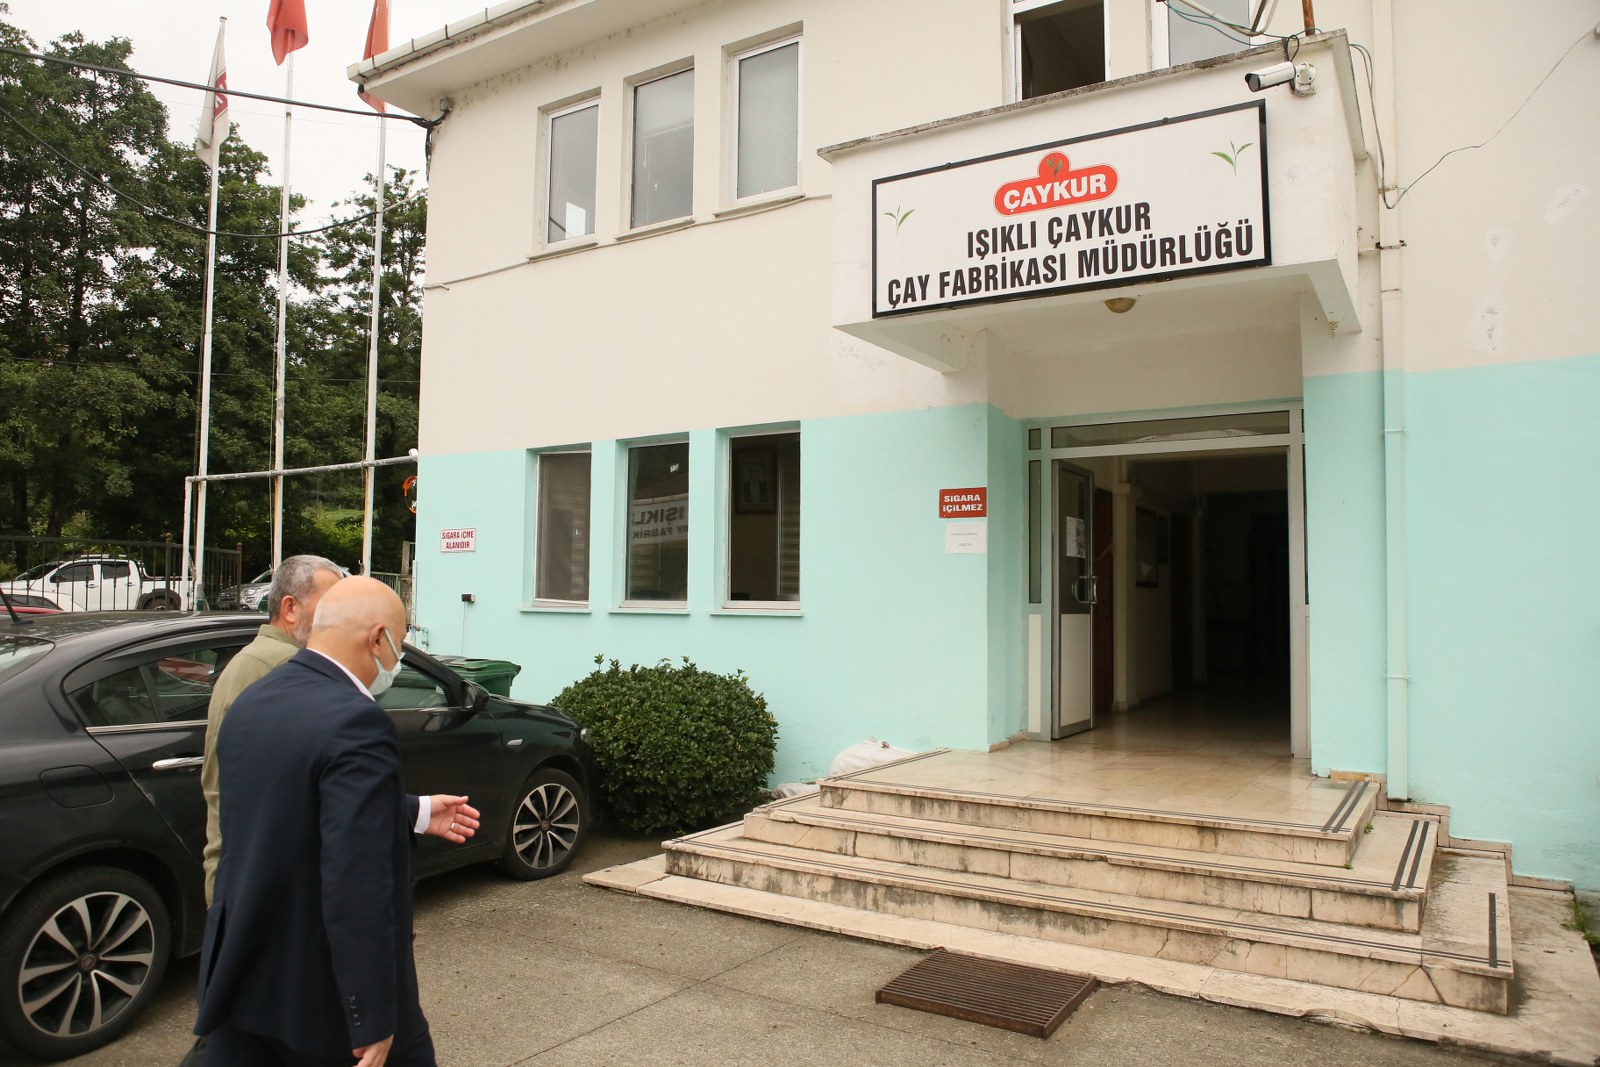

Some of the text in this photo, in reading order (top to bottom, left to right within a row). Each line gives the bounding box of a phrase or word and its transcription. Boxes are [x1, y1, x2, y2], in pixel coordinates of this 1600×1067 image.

[1003, 173, 1108, 214] ÇAYKUR
[967, 202, 1151, 259] IŞIKLI ÇAYKUR
[888, 218, 1254, 308] ÇAY FABRİKASI MÜDÜRLÜĞÜ
[943, 504, 983, 513] İÇİLMEZ
[944, 494, 981, 502] SİGARA
[446, 541, 470, 549] ALANIDIR
